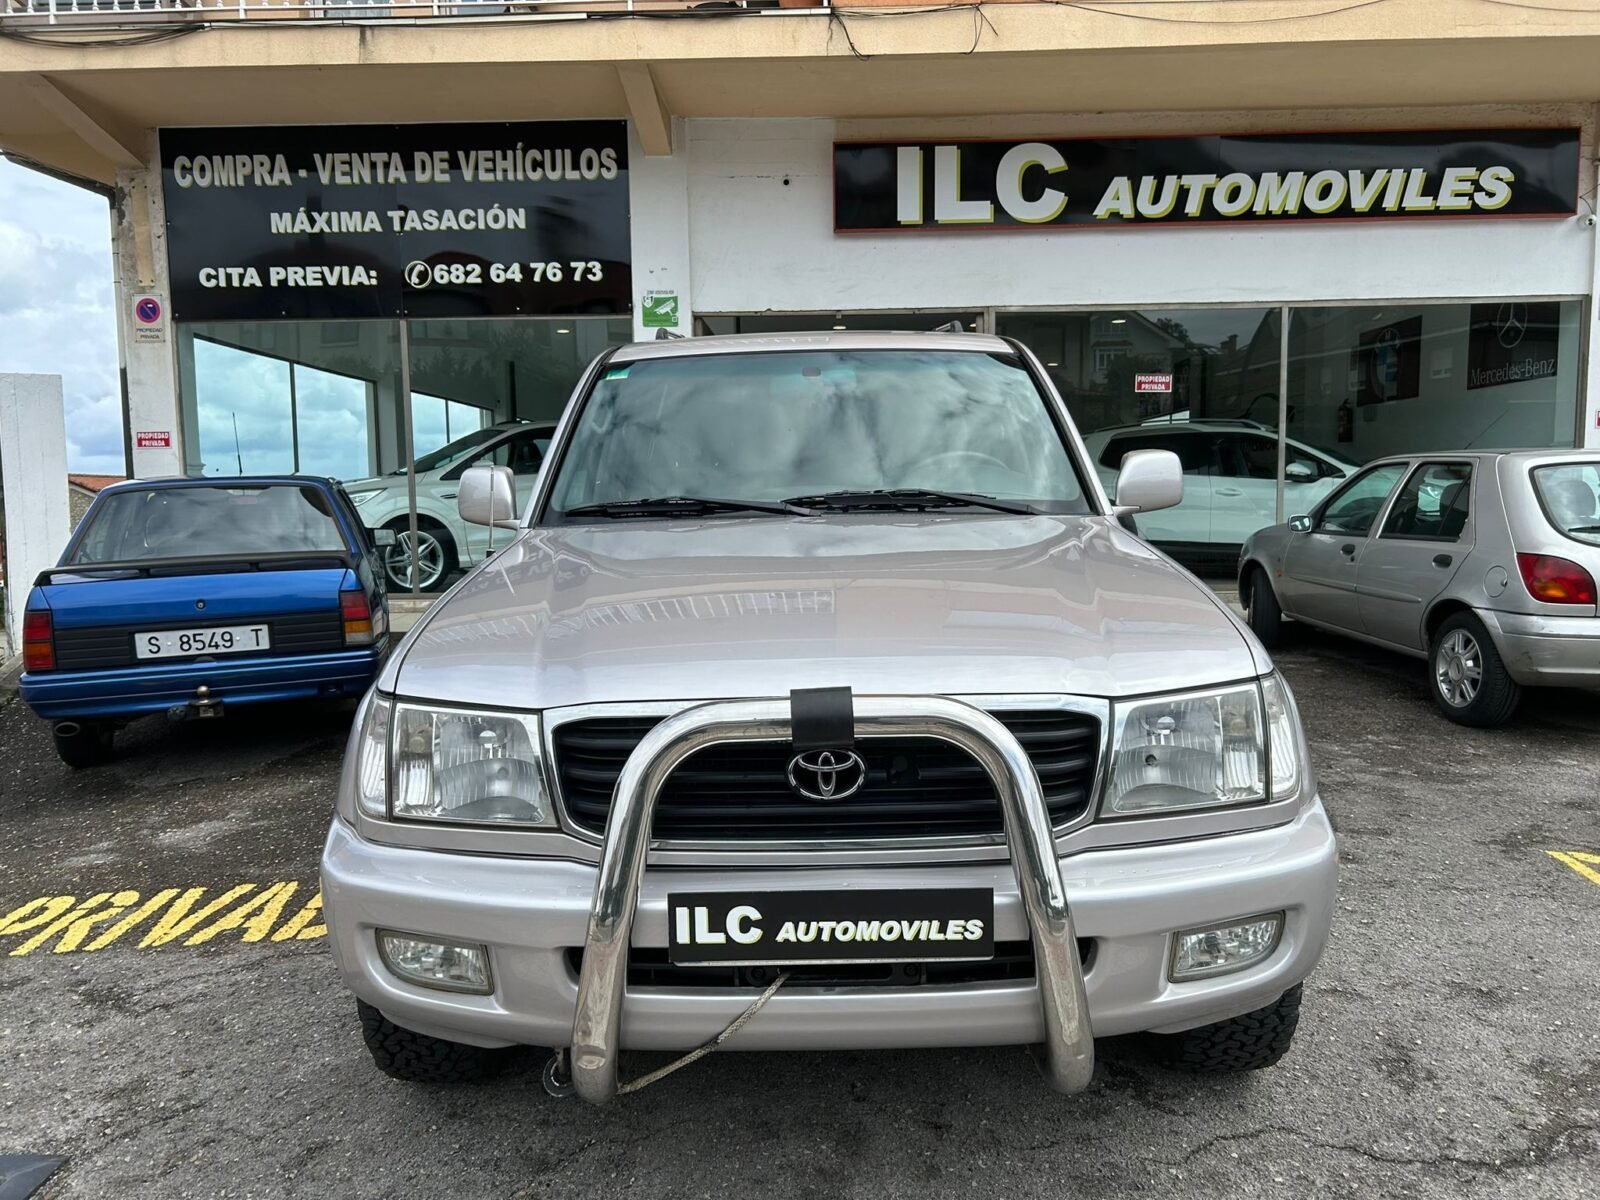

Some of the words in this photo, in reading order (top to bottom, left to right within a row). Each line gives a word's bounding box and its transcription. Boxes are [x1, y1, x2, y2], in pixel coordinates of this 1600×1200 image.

[173, 154, 292, 188] COMPRA
[313, 152, 407, 185] VENTA
[414, 151, 450, 183] DE
[457, 142, 618, 181] VEHÍCULOS
[897, 142, 1068, 224] ILC
[1092, 166, 1515, 219] AUTOMOVILES
[270, 207, 383, 234] MÁXIMA
[387, 203, 526, 231] TASACIÓN
[199, 267, 263, 287] CITA
[269, 266, 378, 287] PREVIA:
[433, 264, 482, 284] 682
[489, 263, 523, 283] 64
[530, 262, 563, 282] 76
[570, 261, 603, 282] 73
[1137, 375, 1170, 383] PROPIEDAD
[1470, 358, 1555, 387] Mercedes-Benz
[147, 636, 161, 654] S
[178, 630, 234, 652] 8549
[250, 628, 263, 647] T
[675, 906, 763, 944] ILC
[775, 919, 984, 943] AUTOMOVILES
